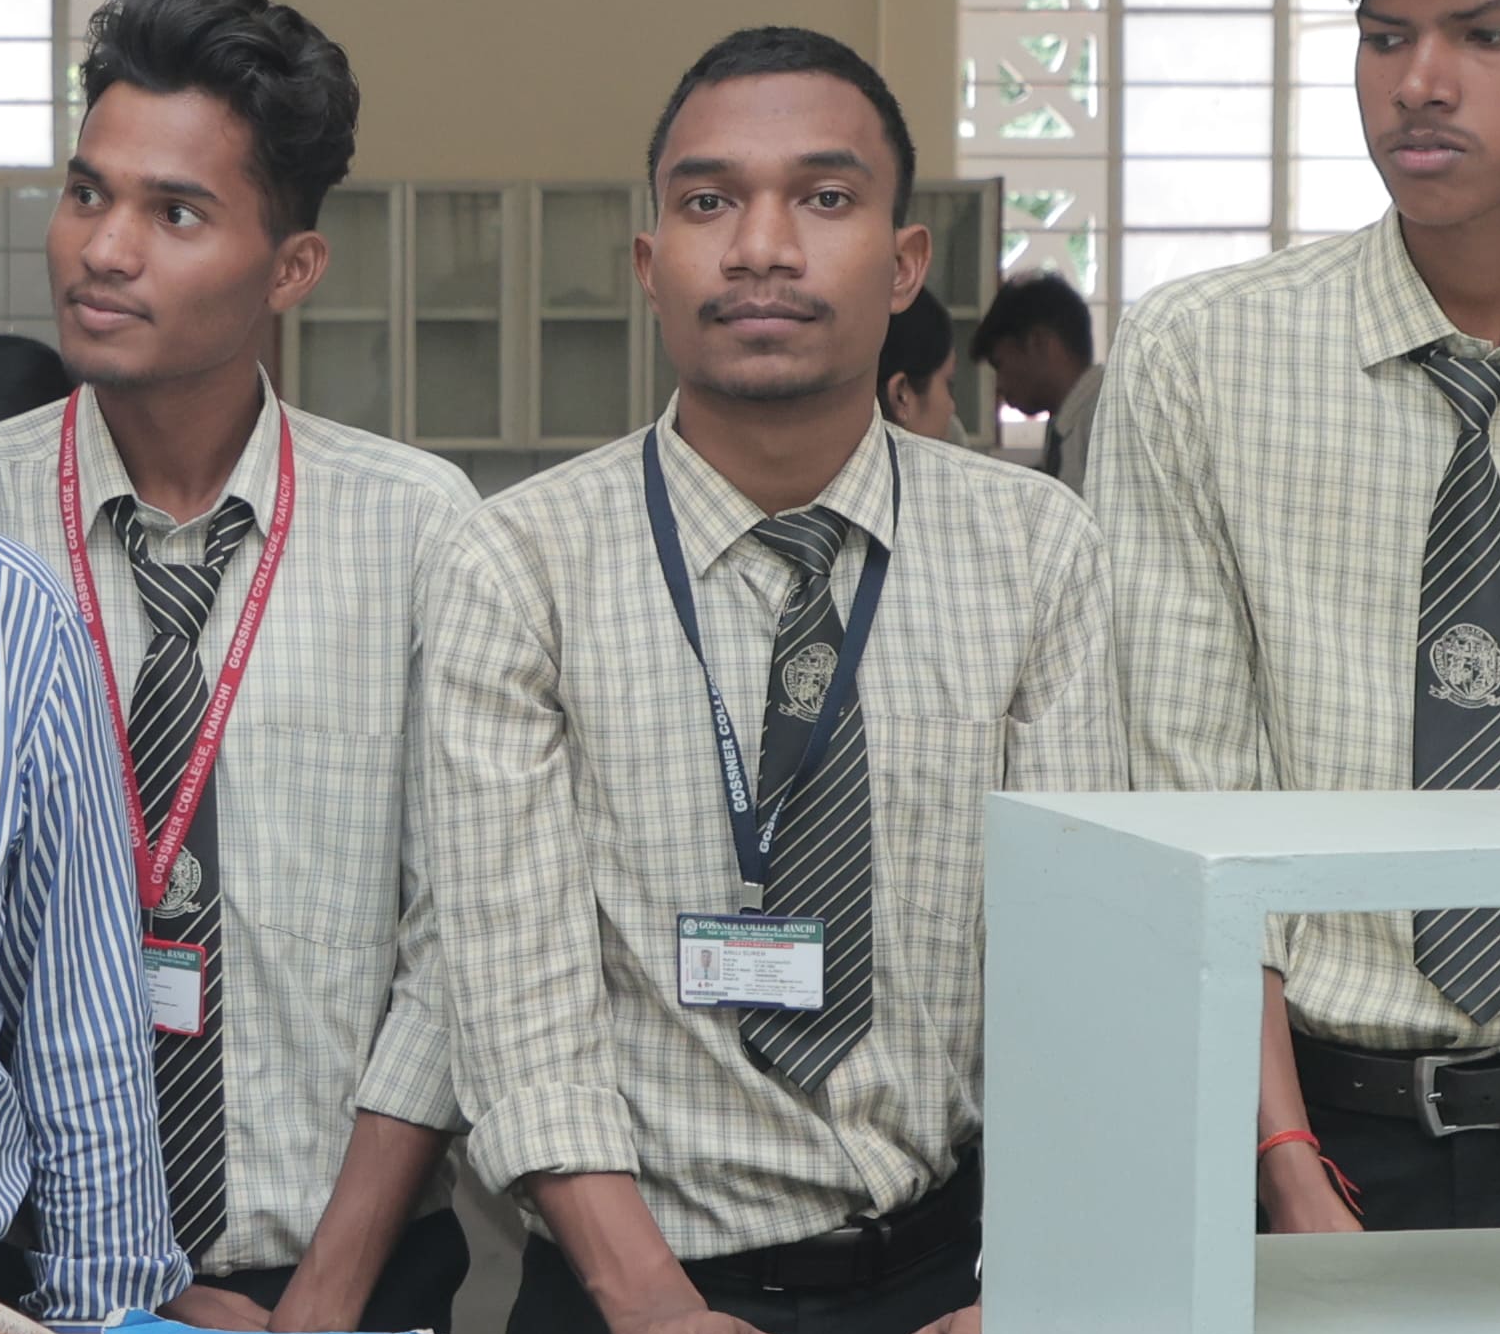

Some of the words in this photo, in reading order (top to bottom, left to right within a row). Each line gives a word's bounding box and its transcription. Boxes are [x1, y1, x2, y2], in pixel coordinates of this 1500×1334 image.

[63, 426, 74, 477] RANCHI
[63, 480, 79, 549] COLLEGE,
[72, 552, 94, 624] GOSSNER
[229, 600, 259, 670] GOSSNER
[255, 530, 284, 599] COLLEGE,
[275, 473, 291, 527] RANCHI
[150, 816, 185, 885] GOSSNER
[176, 743, 214, 815] COLLEGE,
[203, 682, 233, 741] RANCHI
[721, 738, 748, 813] GOSSNER
[783, 924, 816, 934] RANCHI
